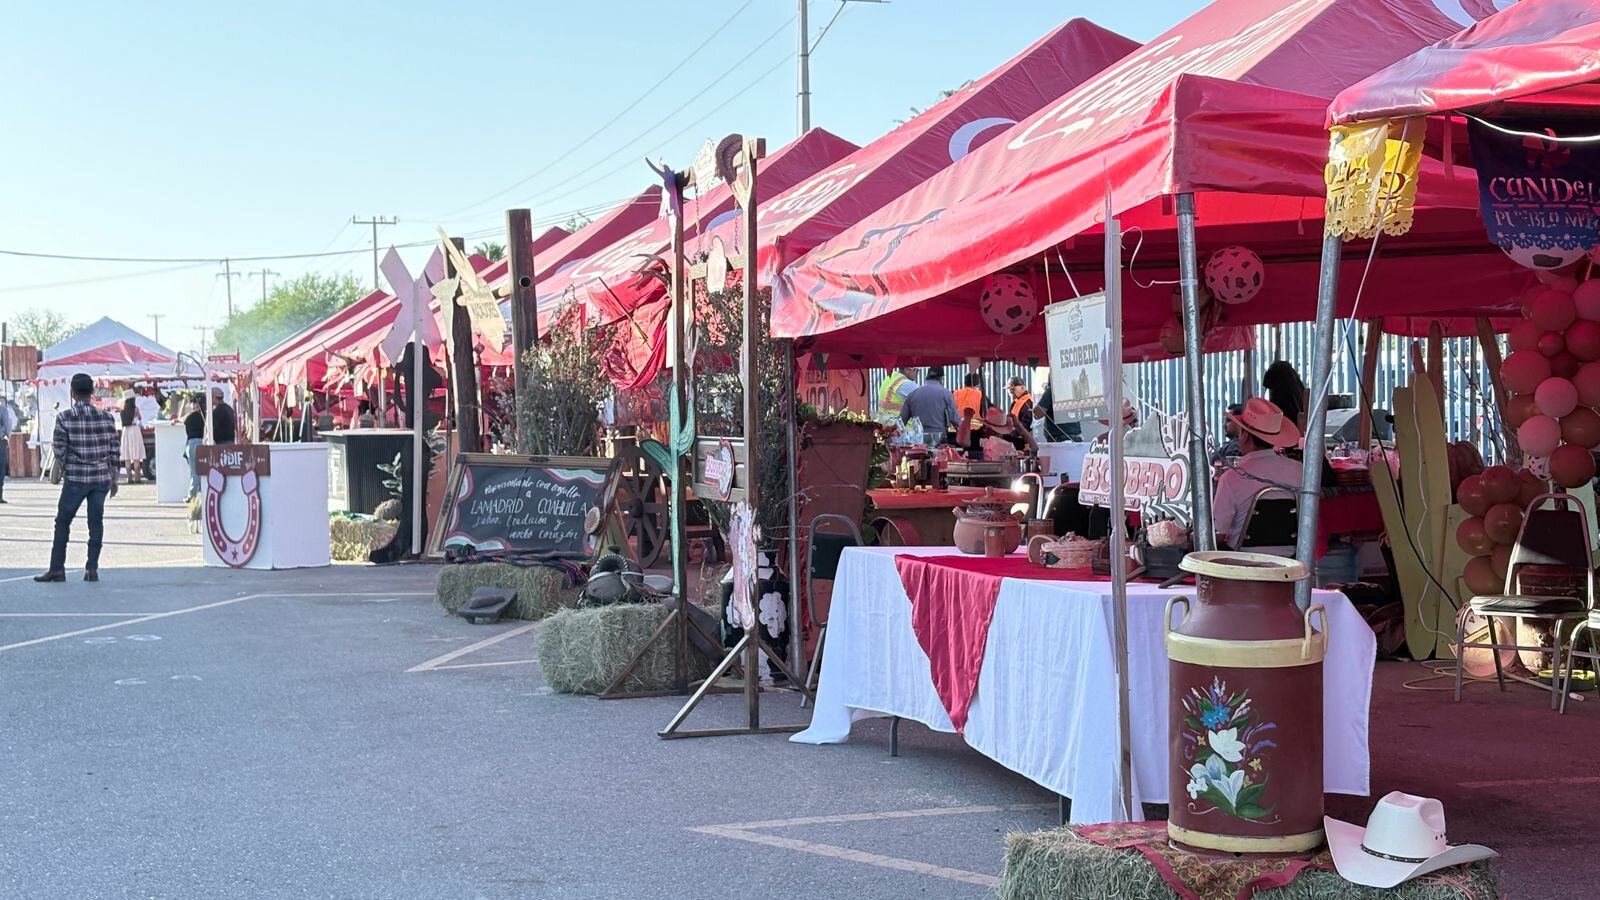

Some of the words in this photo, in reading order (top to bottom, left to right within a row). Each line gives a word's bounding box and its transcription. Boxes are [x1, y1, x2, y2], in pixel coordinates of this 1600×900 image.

[1060, 343, 1099, 368] ESCOBEDO
[1081, 458, 1182, 498] ESCBEDO
[470, 498, 524, 515] LAMADRID
[538, 498, 588, 517] COAHUILA
[554, 518, 565, 531] y
